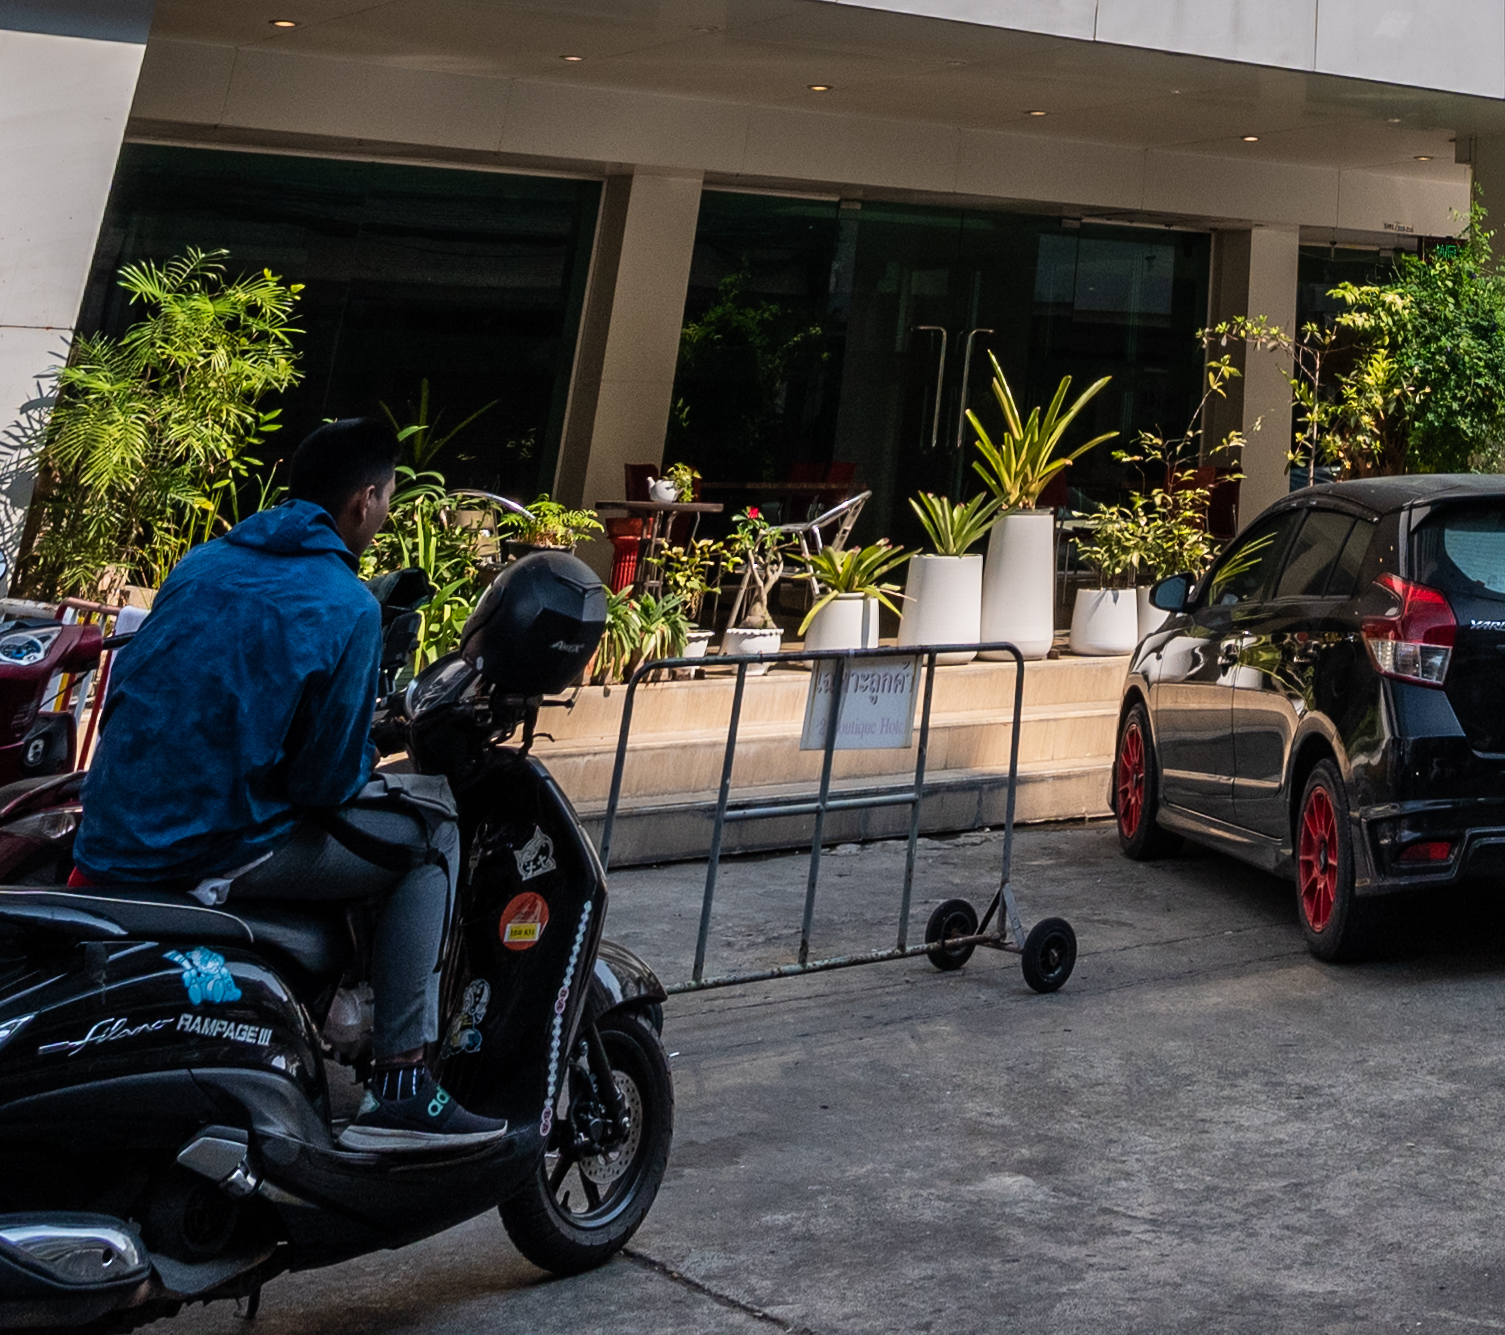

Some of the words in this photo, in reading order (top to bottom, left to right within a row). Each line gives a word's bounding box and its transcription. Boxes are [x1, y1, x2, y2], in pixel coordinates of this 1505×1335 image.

[817, 660, 915, 705] เฉาะลูกค้า
[840, 717, 877, 738] outique
[176, 1013, 258, 1045] RAMPAGE
